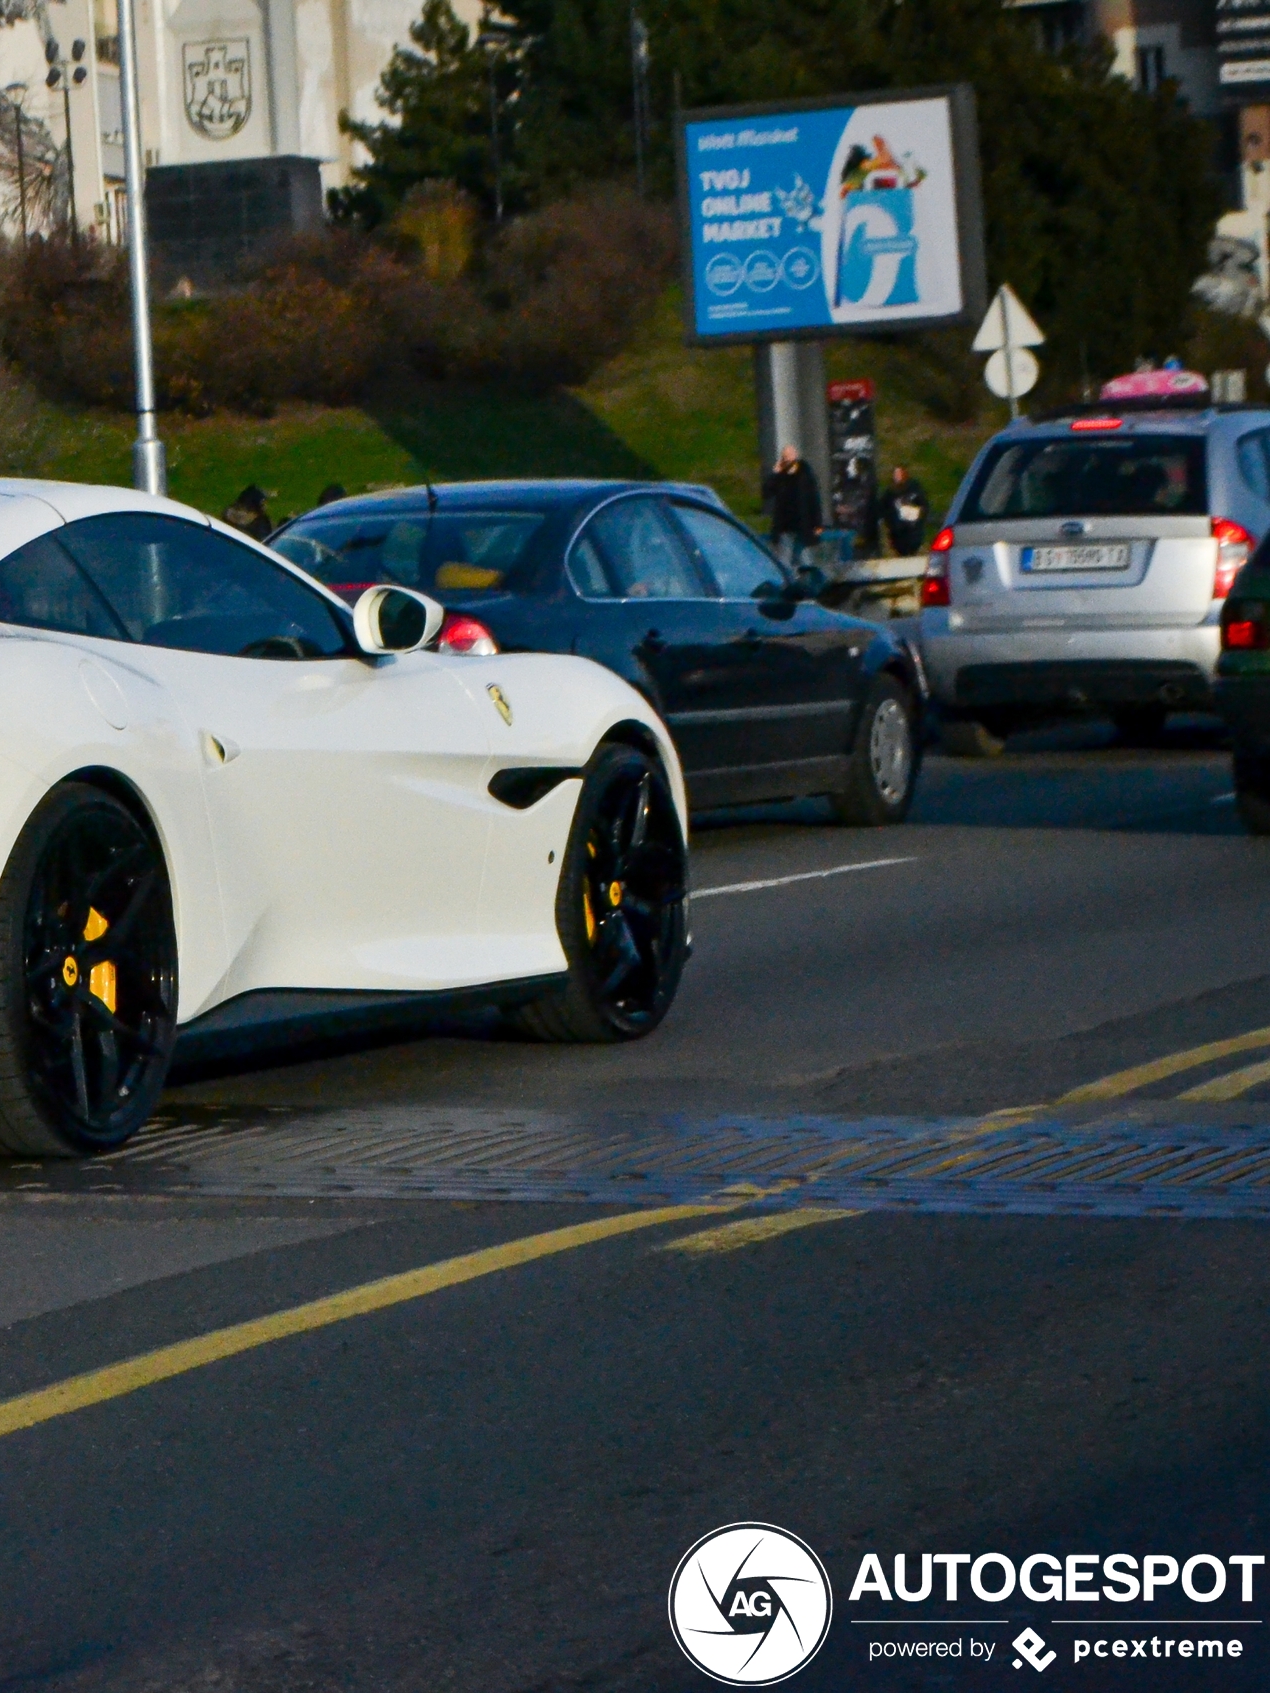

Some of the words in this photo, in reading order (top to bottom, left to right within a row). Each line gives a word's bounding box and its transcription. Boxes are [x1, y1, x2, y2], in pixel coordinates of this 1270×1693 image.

[699, 168, 750, 191] TVOJ
[702, 192, 772, 217] ONLINE
[703, 217, 783, 243] MARKET
